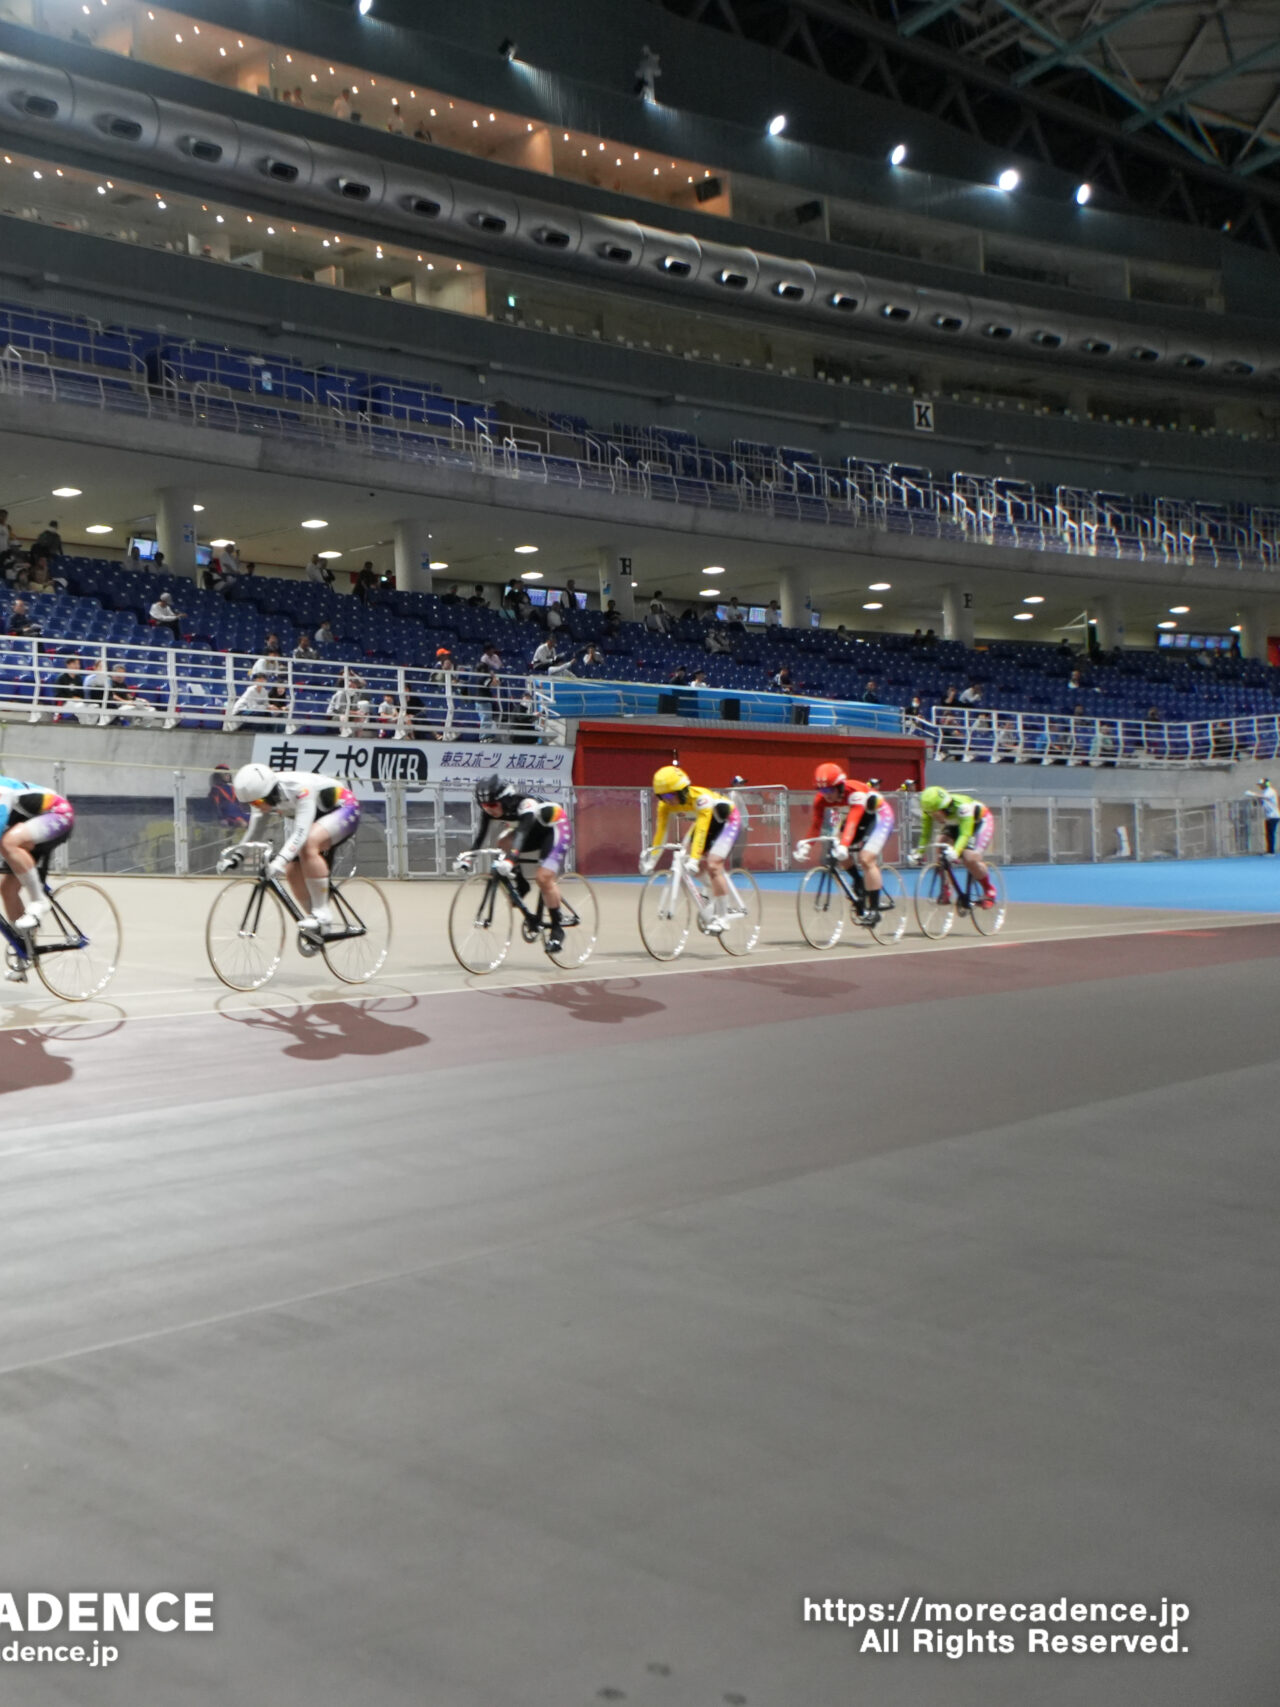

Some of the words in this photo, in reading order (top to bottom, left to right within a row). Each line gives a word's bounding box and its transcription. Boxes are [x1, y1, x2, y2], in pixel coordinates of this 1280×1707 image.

[915, 404, 932, 428] K
[440, 751, 502, 768] 東京スポーツ
[506, 753, 565, 769] 大阪スポーツ
